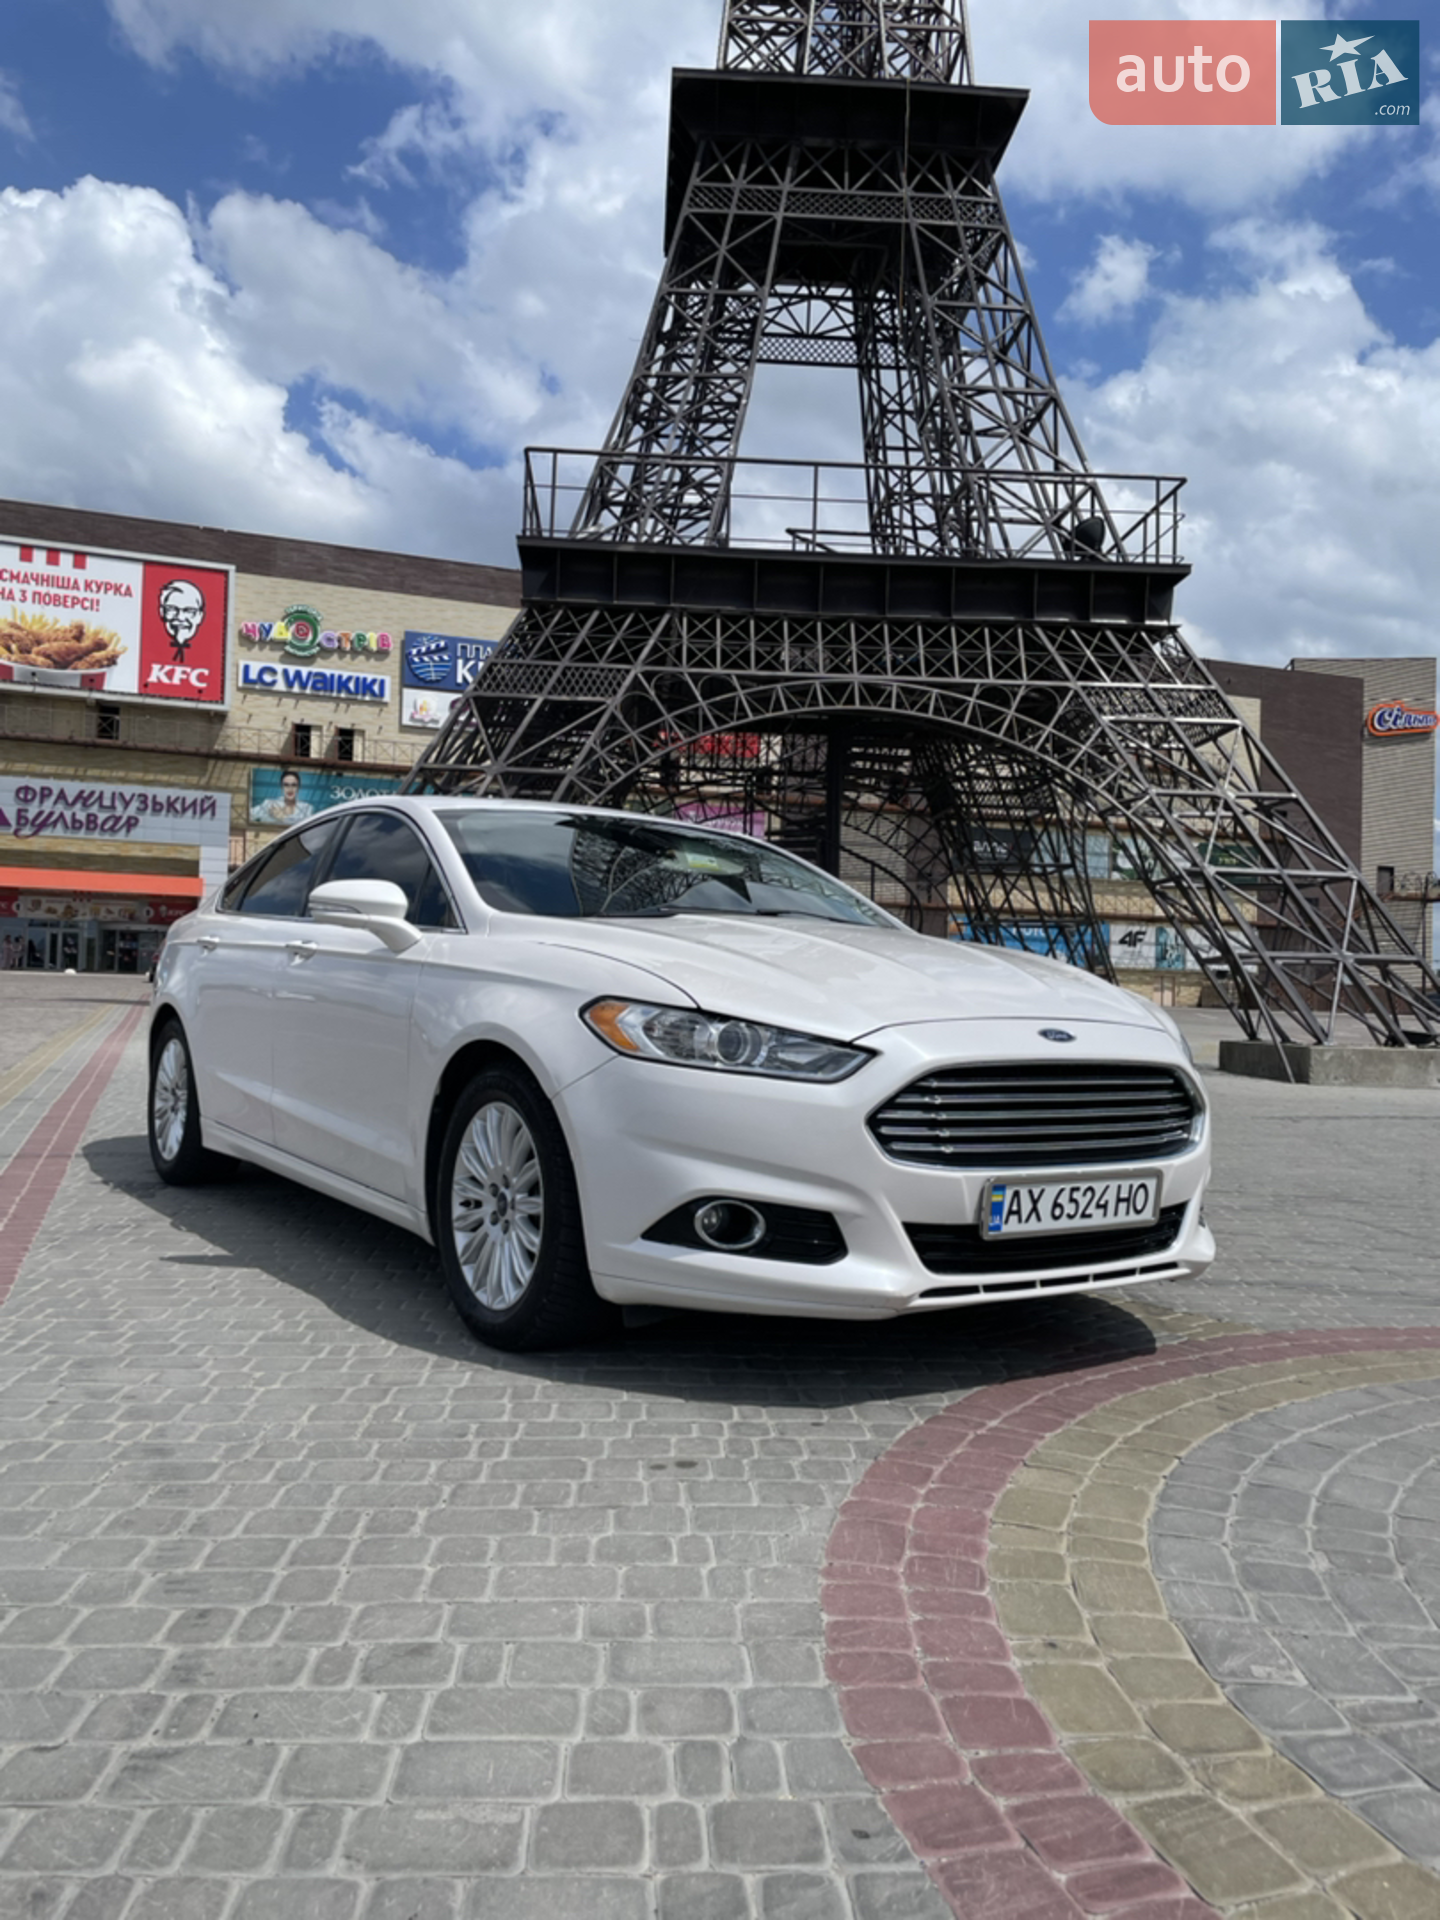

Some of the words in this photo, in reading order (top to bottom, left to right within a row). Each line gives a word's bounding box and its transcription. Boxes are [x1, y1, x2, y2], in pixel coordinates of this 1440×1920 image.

[0, 568, 80, 592] СМАЧНІША
[84, 579, 133, 598] КУРКА
[32, 591, 100, 612] ПОВЕРСІ!
[147, 663, 210, 688] KFC
[242, 664, 278, 687] LC
[1118, 930, 1147, 948] 4F
[1004, 1188, 1046, 1225] AX
[1050, 1184, 1111, 1221] 6524
[1114, 1182, 1149, 1218] HO
